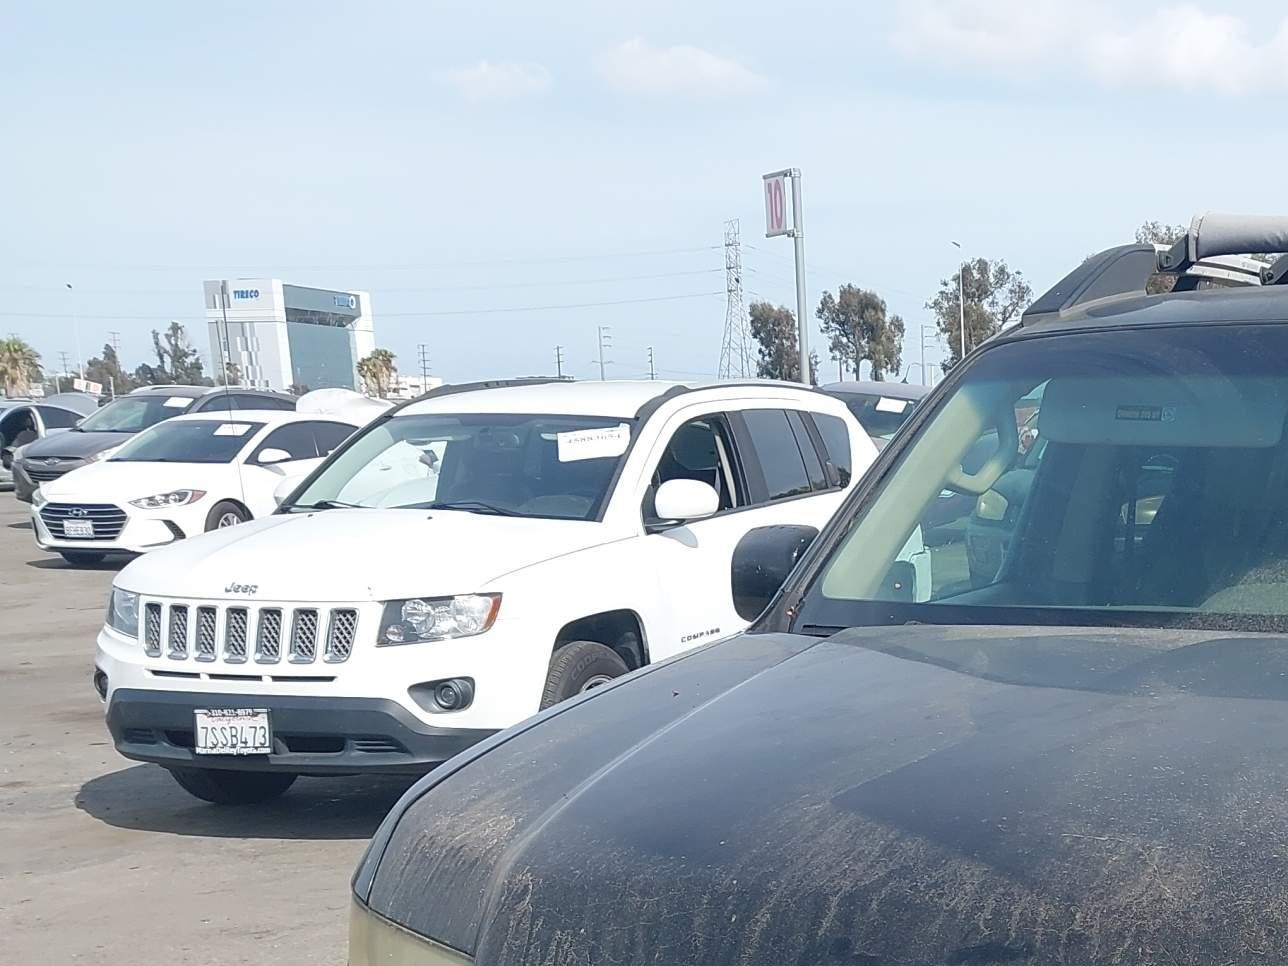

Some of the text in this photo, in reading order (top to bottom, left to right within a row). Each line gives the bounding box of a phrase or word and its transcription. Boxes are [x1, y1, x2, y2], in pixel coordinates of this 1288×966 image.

[233, 289, 260, 300] TIRECO
[224, 581, 259, 596] Jeep
[199, 725, 267, 748] 7SSB473
